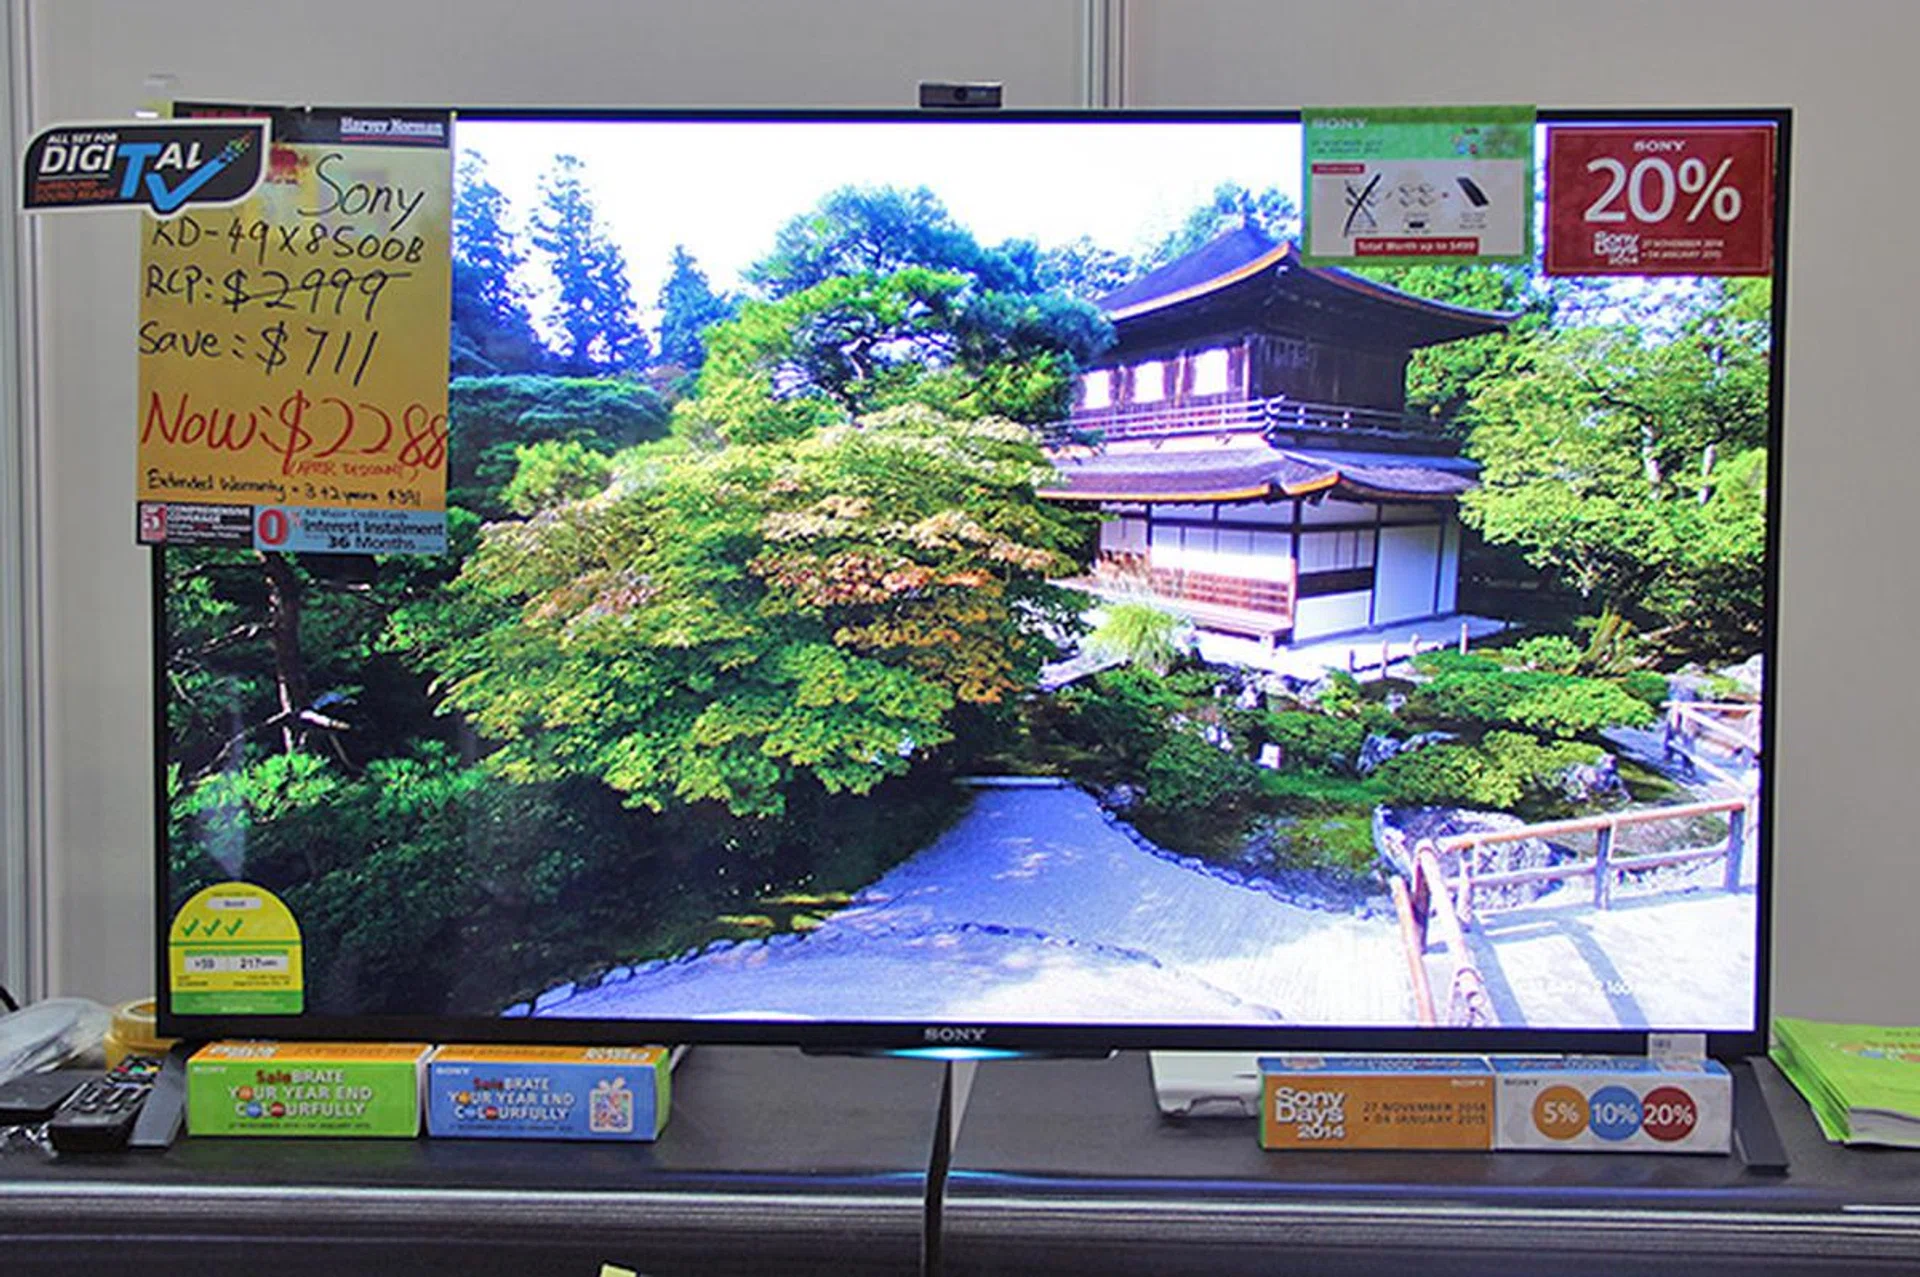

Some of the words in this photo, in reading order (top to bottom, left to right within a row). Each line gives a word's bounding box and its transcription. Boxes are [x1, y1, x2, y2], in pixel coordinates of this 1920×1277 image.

[1633, 140, 1686, 151] SONY
[297, 153, 424, 232] Sony
[1584, 153, 1742, 223] 20%
[222, 267, 390, 322] $2999
[279, 389, 447, 476] $2288
[304, 519, 361, 533] Interest
[924, 1027, 987, 1041] SONY
[285, 1085, 330, 1101] YEAR
[336, 1086, 373, 1101] END
[496, 1091, 538, 1105] YEAR
[1275, 1086, 1345, 1109] Sony
[1275, 1101, 1345, 1127] Days
[1382, 1103, 1454, 1113] NOVEMBER
[1543, 1102, 1579, 1123] 5%
[1591, 1101, 1639, 1125] 10%
[1643, 1102, 1695, 1127] 20%
[1397, 1114, 1453, 1125] JANUARY
[1297, 1124, 1346, 1140] 2014
